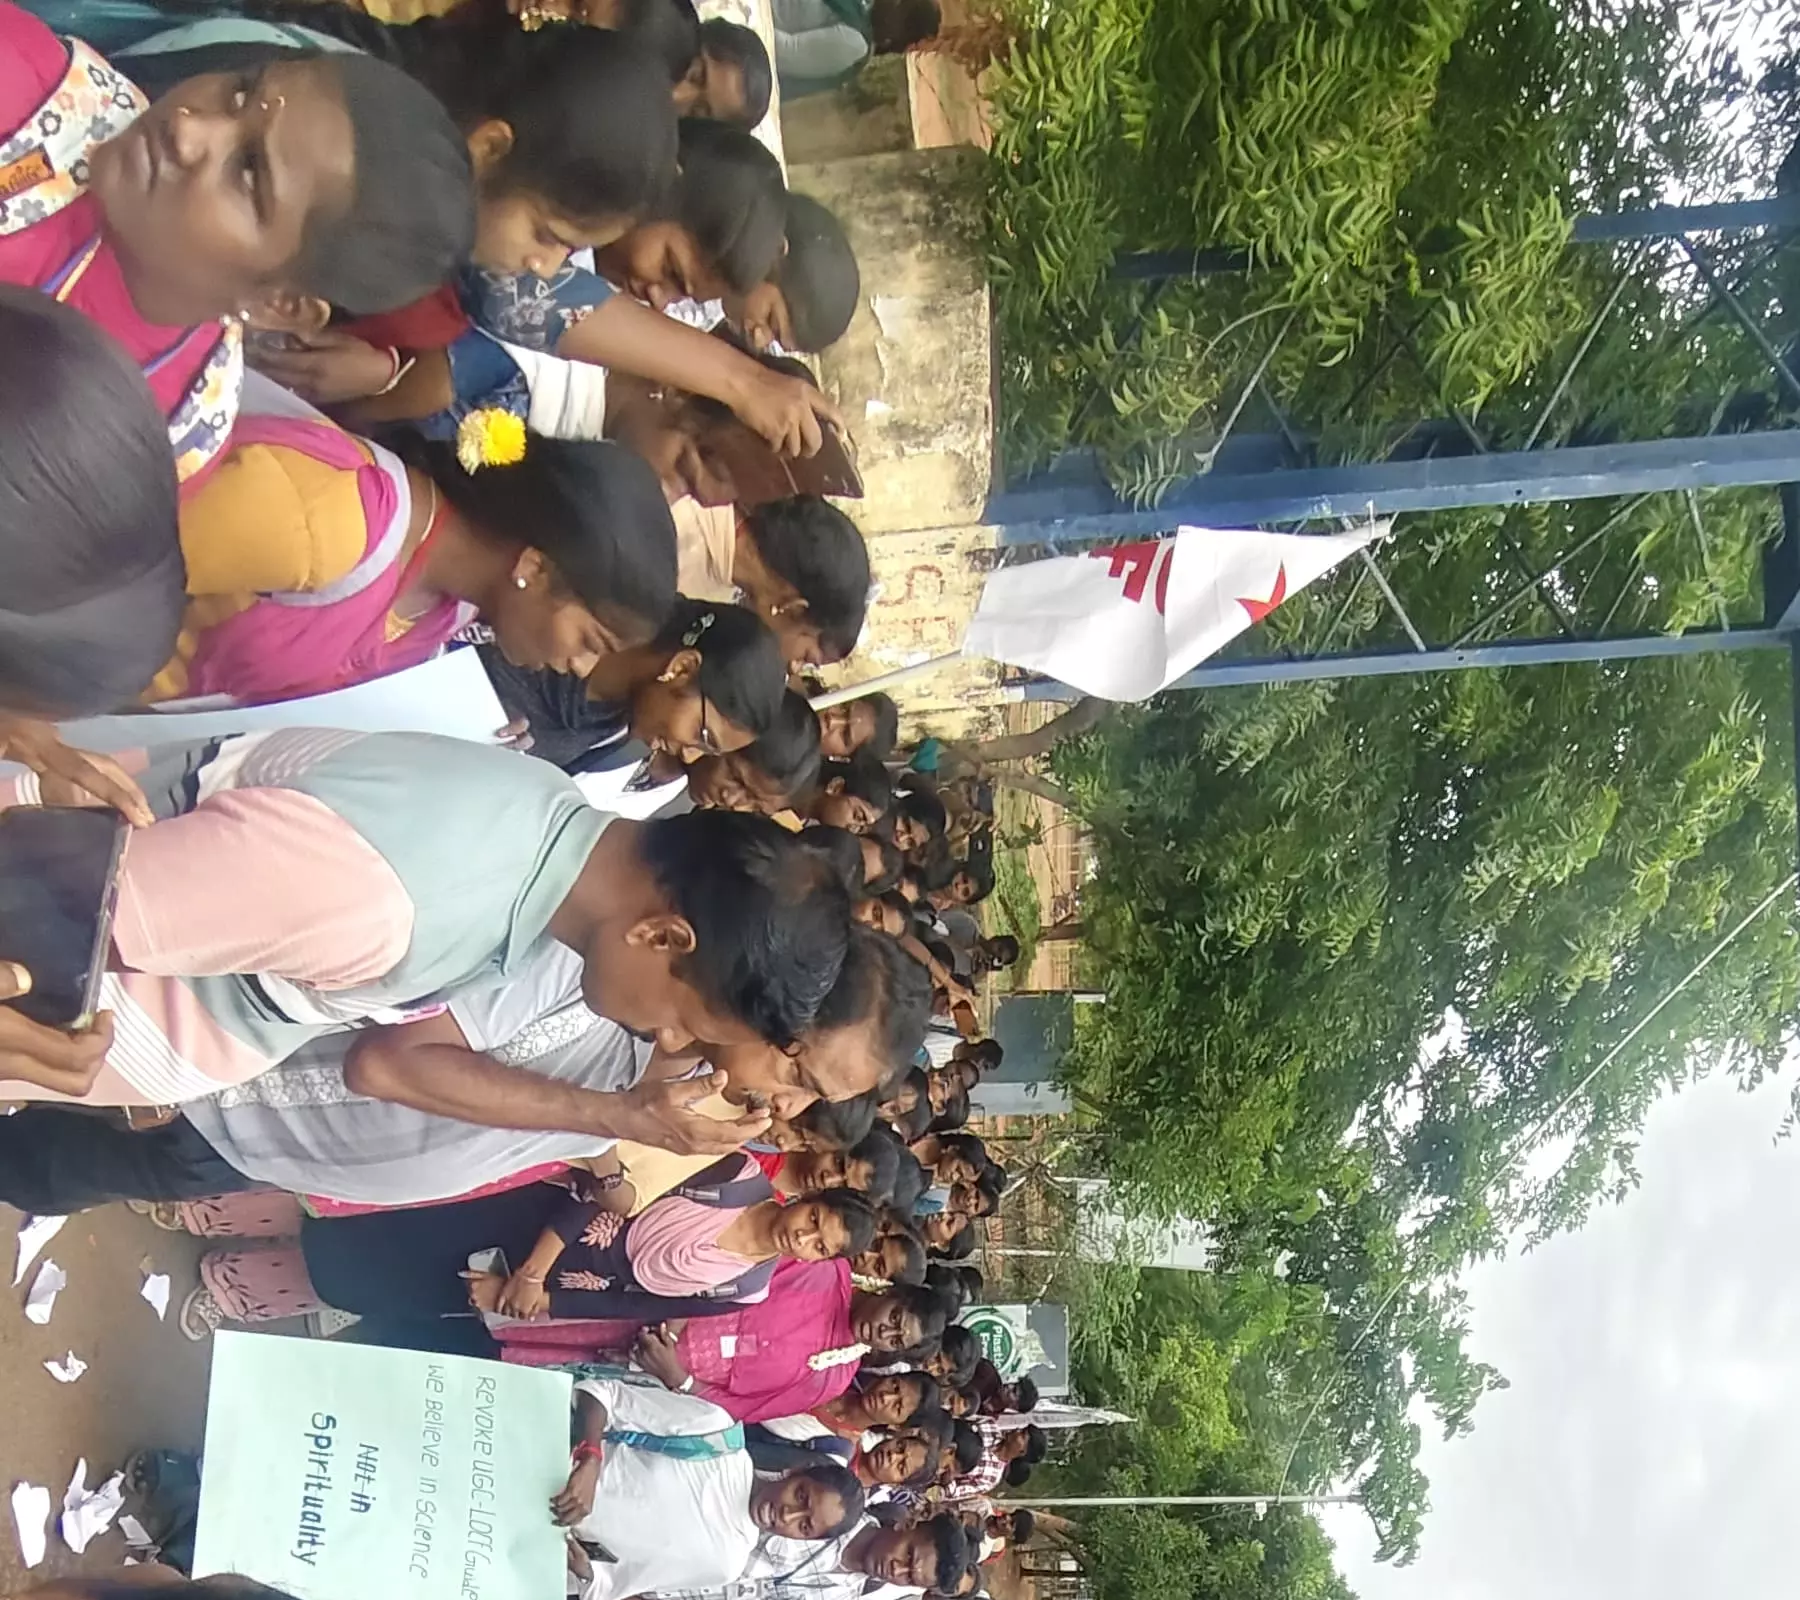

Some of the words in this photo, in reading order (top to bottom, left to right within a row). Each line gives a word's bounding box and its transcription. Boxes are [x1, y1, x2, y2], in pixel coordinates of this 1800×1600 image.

[425, 1364, 444, 1393] We
[420, 1398, 444, 1468] Believe
[290, 1412, 336, 1566] Spirituality
[419, 1477, 437, 1494] in
[408, 1499, 436, 1579] Science
